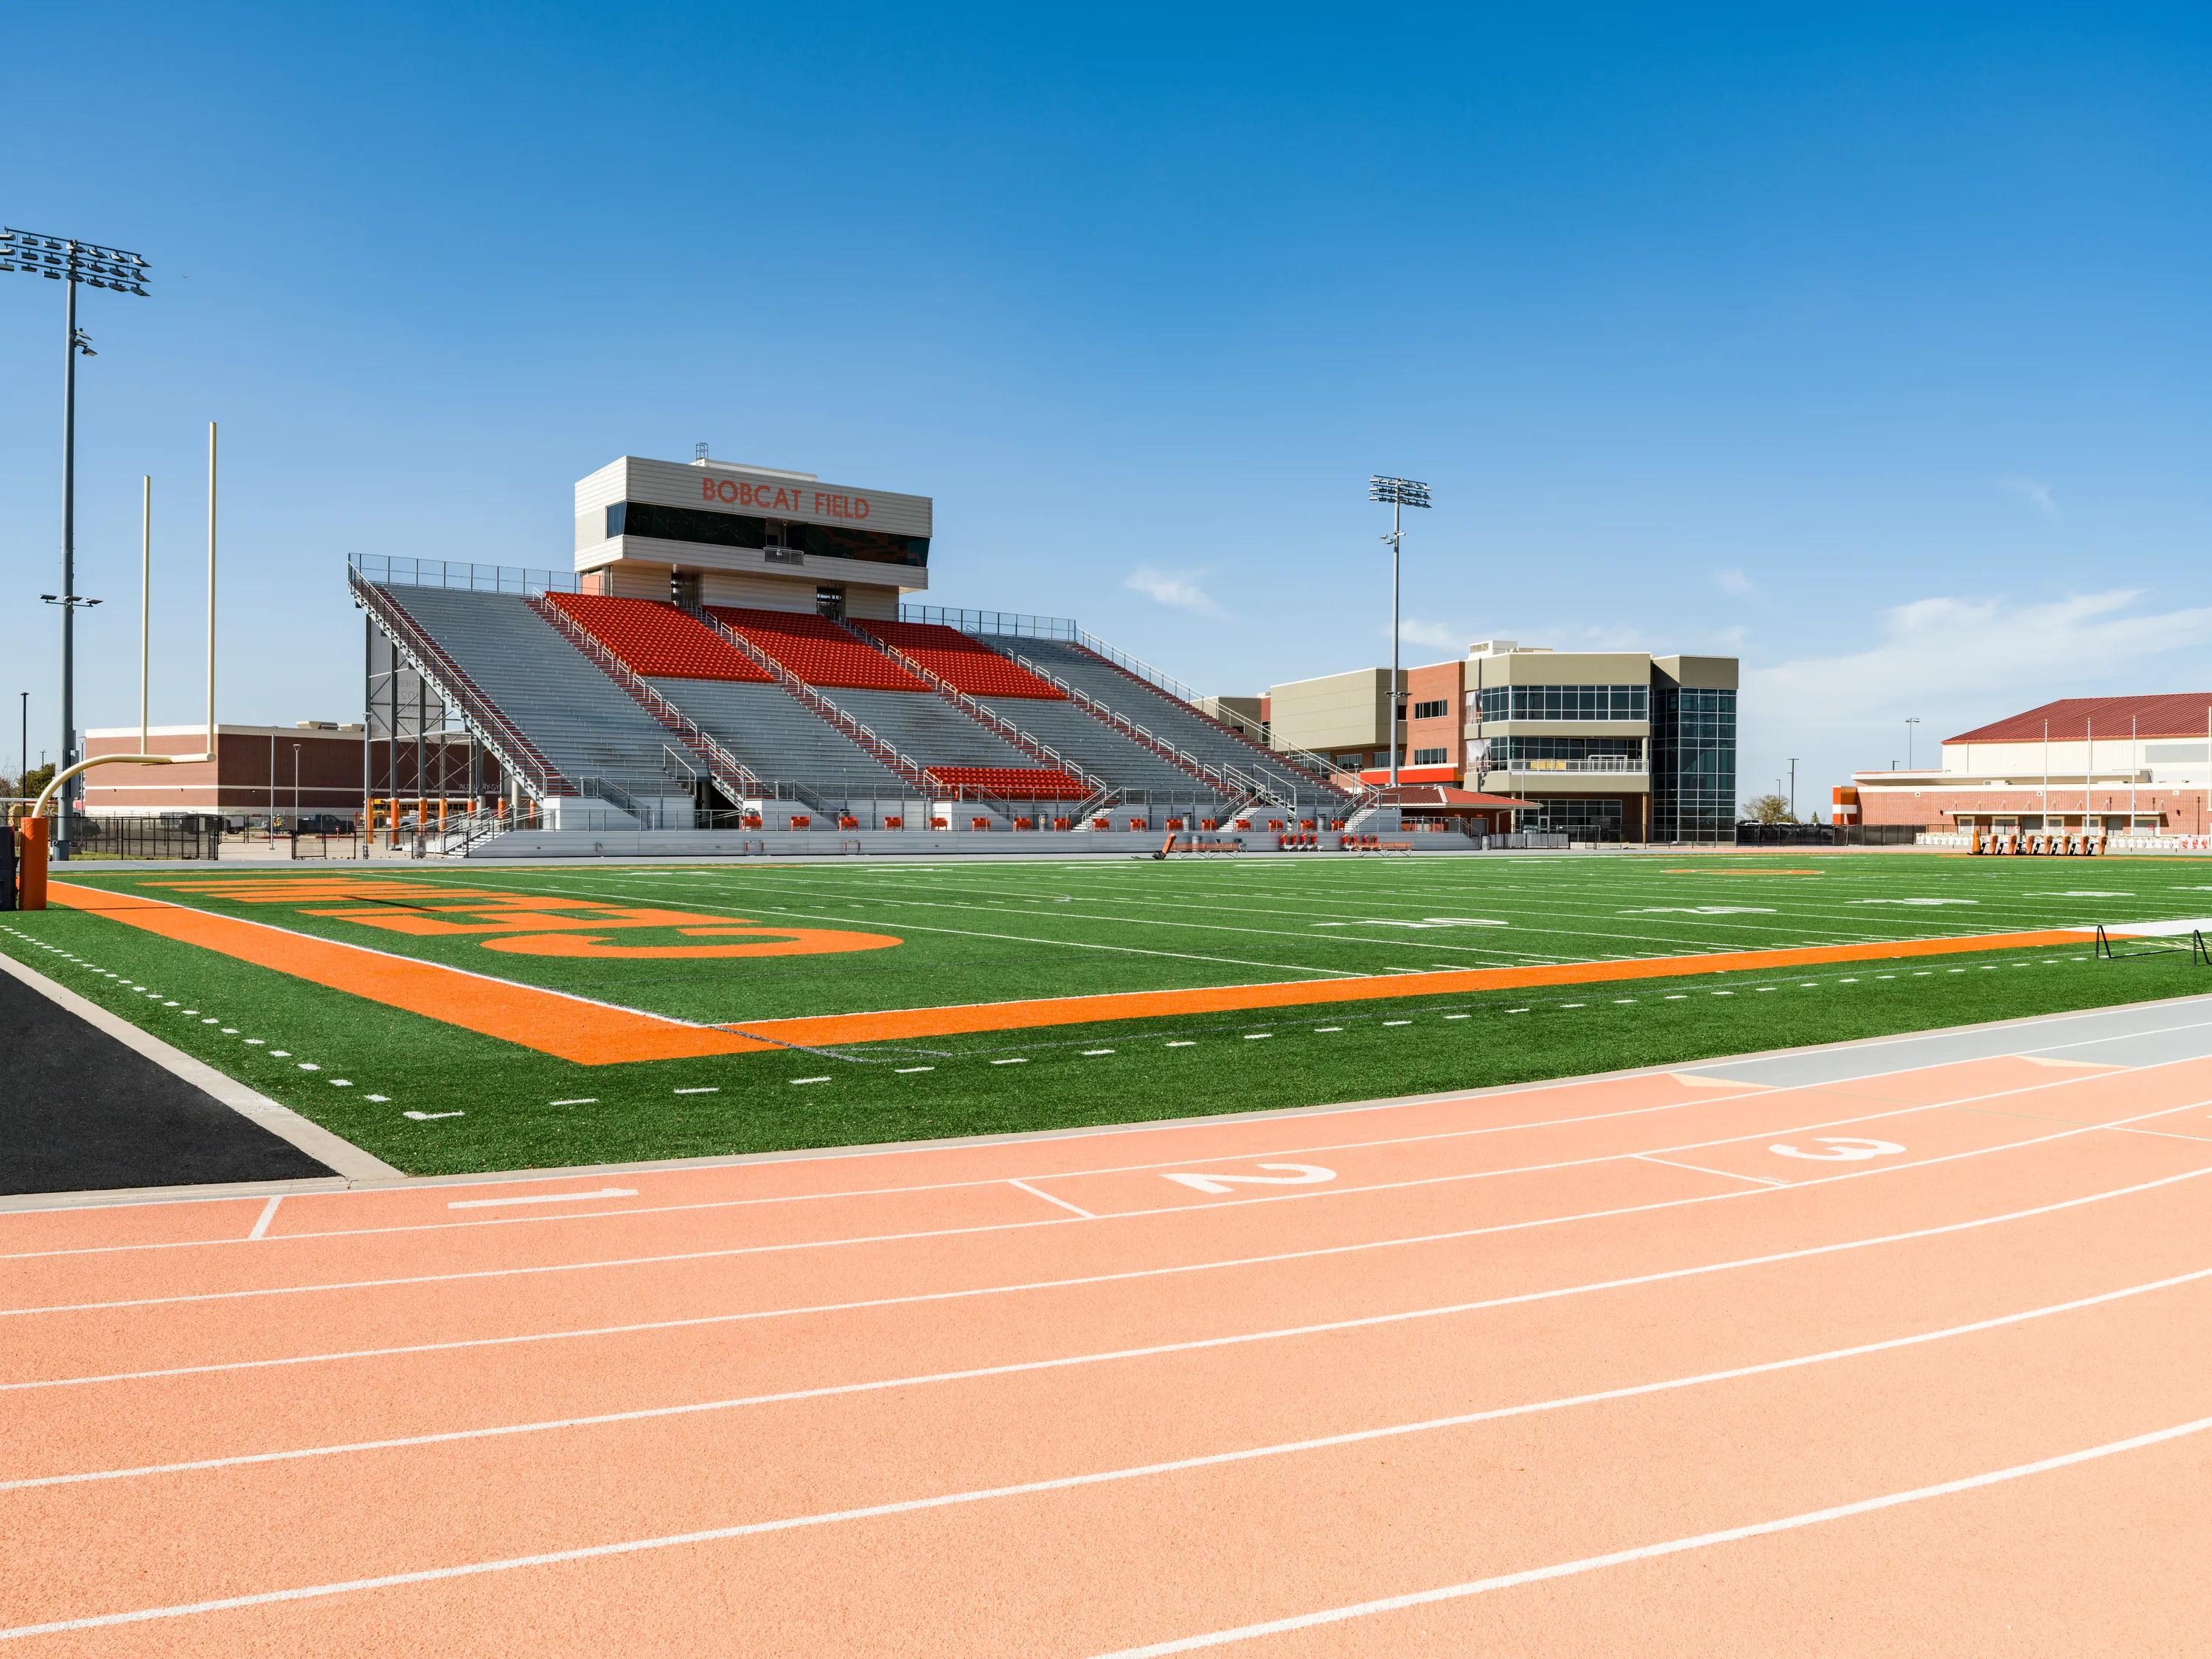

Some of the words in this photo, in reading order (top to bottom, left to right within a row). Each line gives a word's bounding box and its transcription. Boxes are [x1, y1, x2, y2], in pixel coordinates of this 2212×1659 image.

[703, 477, 802, 512] BOBCAT
[814, 492, 870, 519] FIELD
[134, 877, 904, 959] CELINA
[1768, 1137, 1907, 1161] 3
[1158, 1163, 1337, 1194] 2
